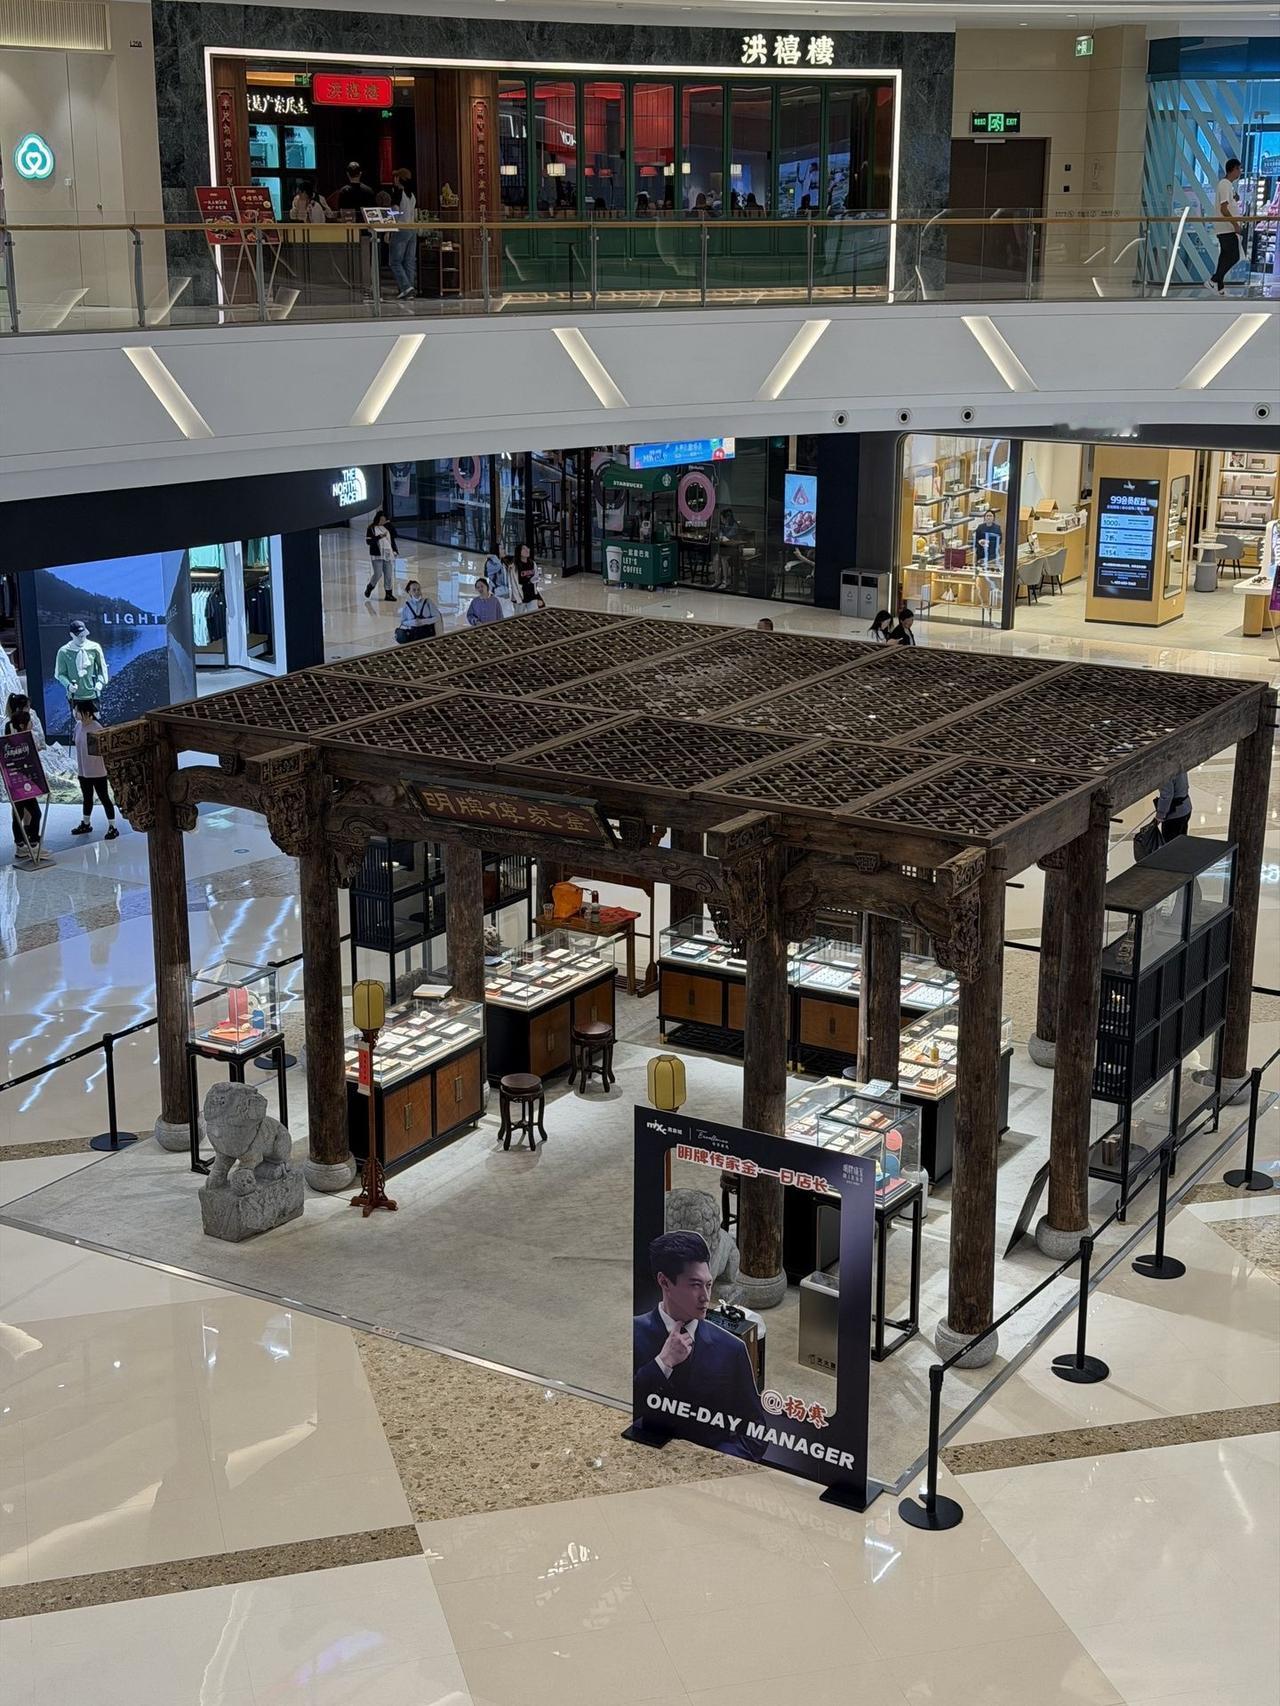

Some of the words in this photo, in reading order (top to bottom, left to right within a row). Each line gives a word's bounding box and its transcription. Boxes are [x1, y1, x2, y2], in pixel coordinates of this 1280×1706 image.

[741, 33, 835, 65] 洪禧樓
[342, 468, 355, 482] THE
[332, 481, 356, 497] NORTH
[613, 480, 643, 489] STARBUCKS
[340, 492, 357, 507] FACE
[622, 565, 642, 575] COFFEE
[103, 613, 159, 624] LIGHT
[646, 1393, 742, 1432] ONE-DAY
[746, 1421, 855, 1470] MANAGER
